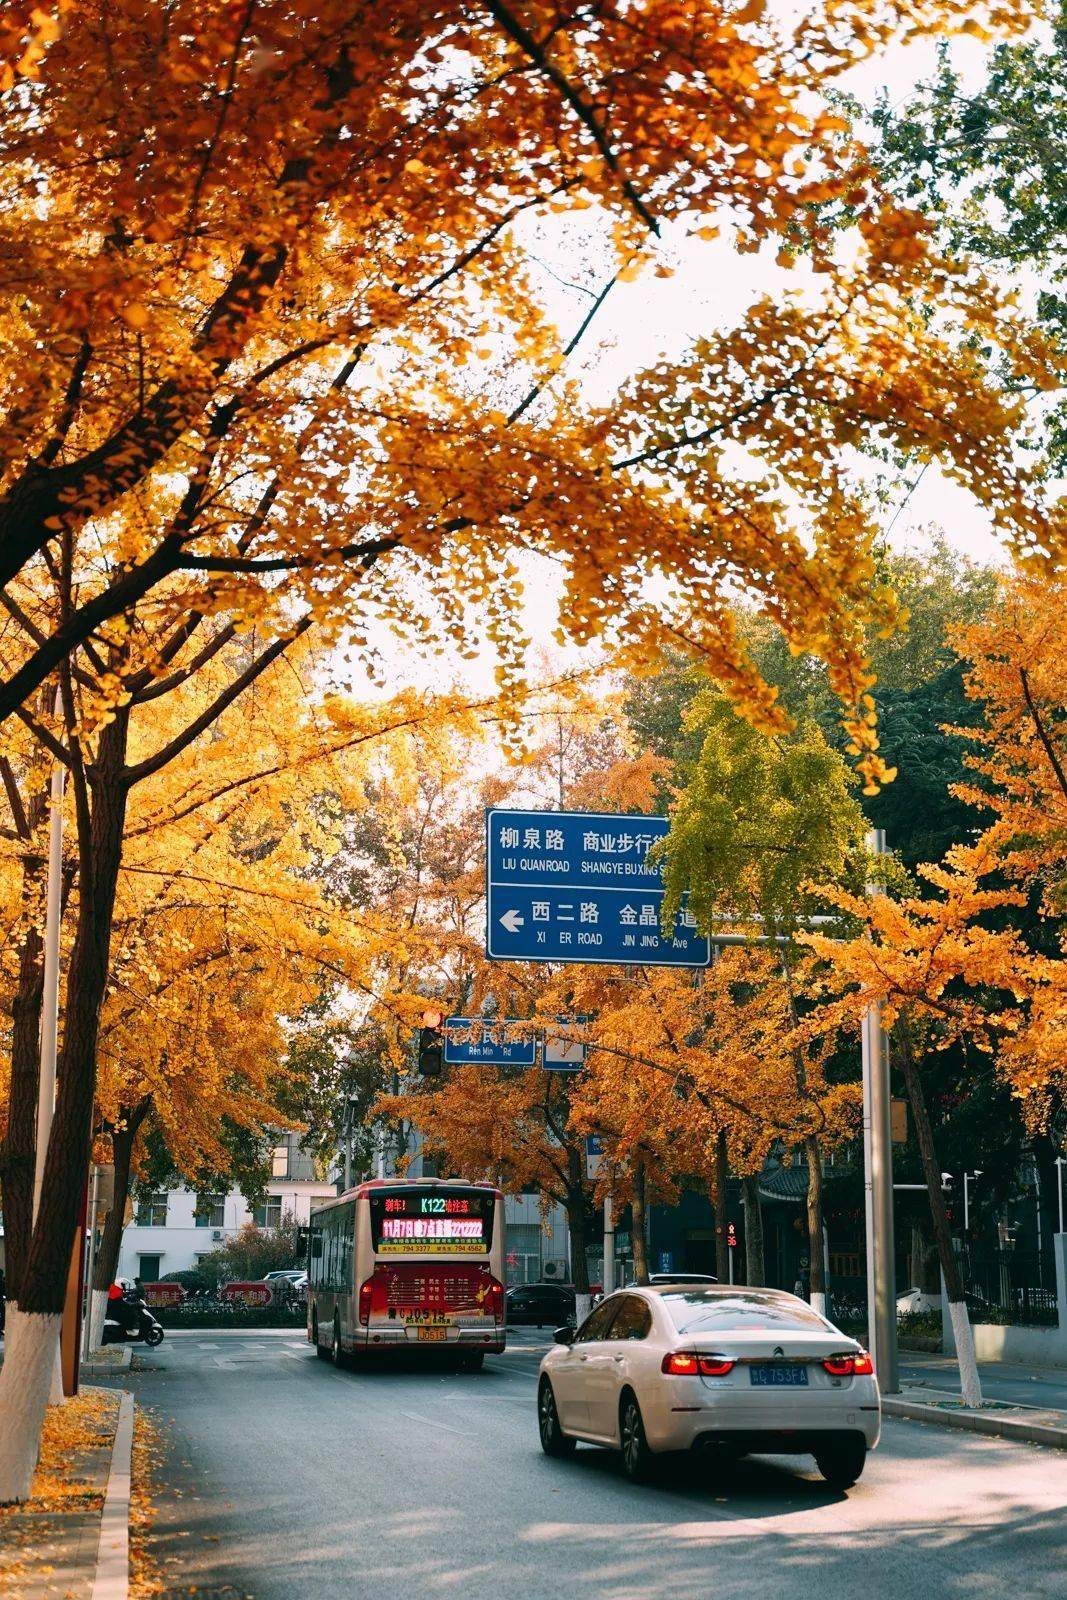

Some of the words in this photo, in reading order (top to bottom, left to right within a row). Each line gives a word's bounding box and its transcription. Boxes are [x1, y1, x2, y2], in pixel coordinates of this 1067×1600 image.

[500, 827, 565, 851] 柳泉路
[502, 858, 516, 870] LIU
[531, 901, 600, 924] 西二路
[619, 903, 698, 928] 金晶道
[536, 931, 546, 943] XI
[559, 931, 572, 944] ER
[577, 932, 603, 945] ROAD
[622, 934, 636, 947] JIN
[640, 935, 659, 948] JING
[672, 936, 688, 949] Ave
[503, 1047, 512, 1057] Rd
[421, 1198, 446, 1213] K122
